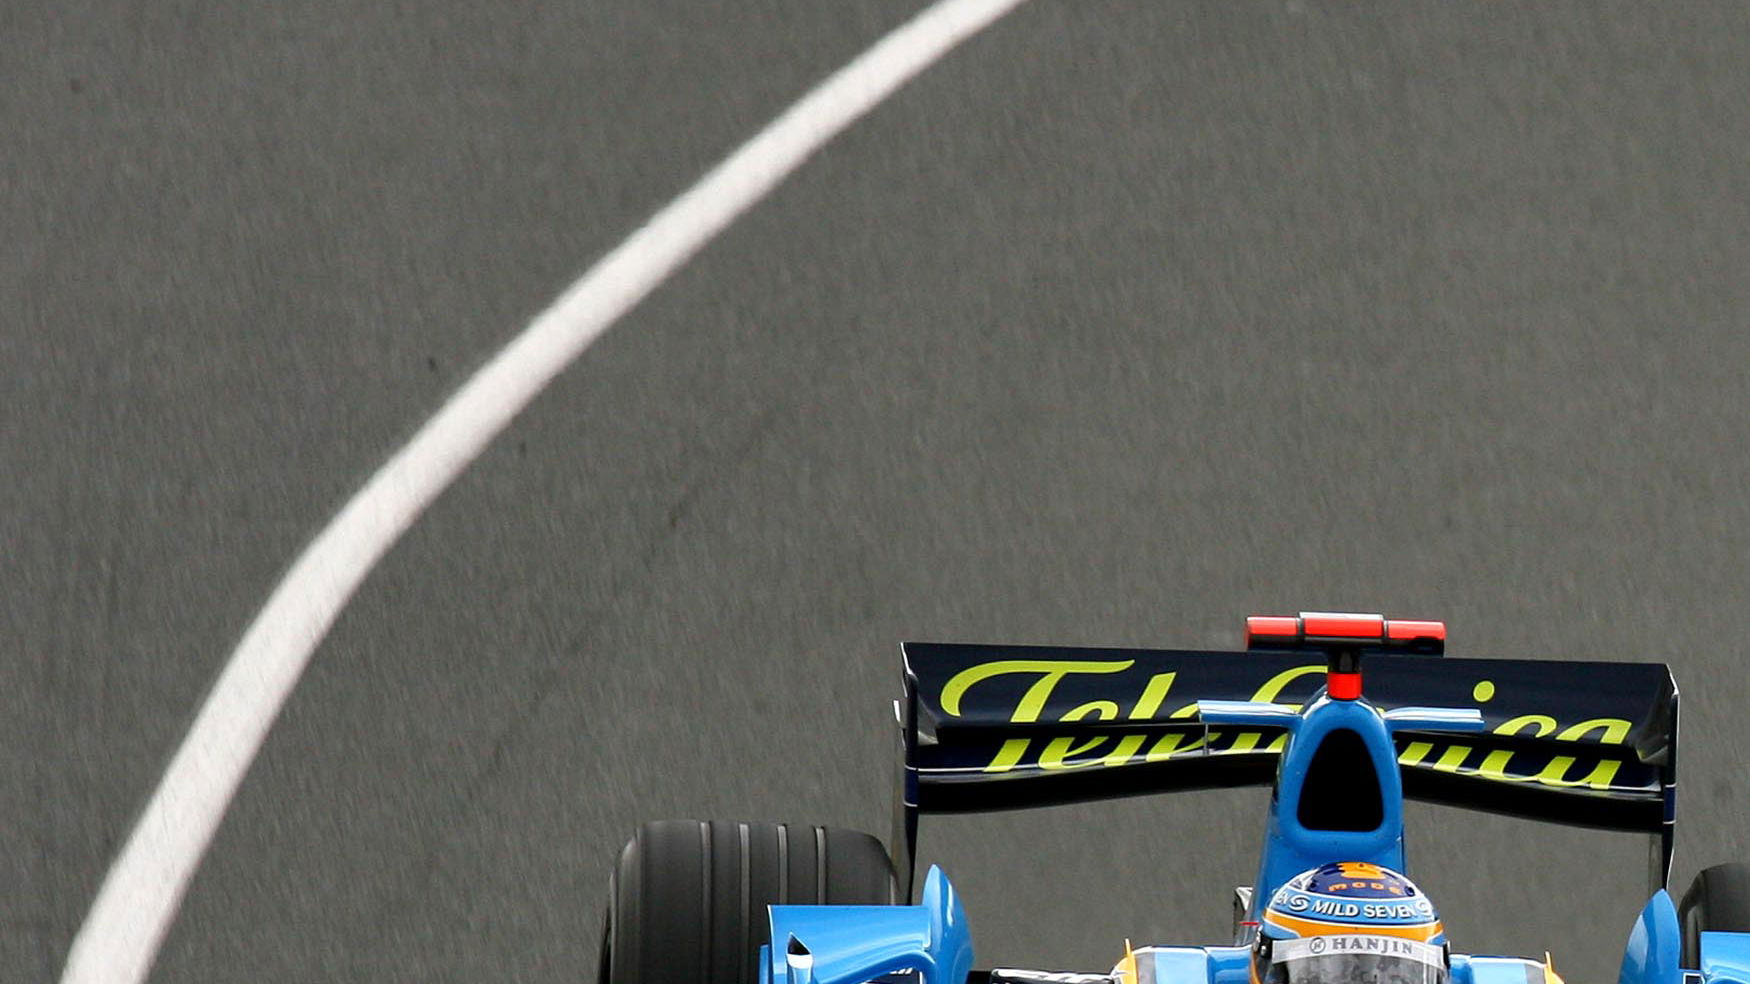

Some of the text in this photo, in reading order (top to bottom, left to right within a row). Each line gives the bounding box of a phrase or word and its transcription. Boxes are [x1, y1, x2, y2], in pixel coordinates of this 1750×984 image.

[1312, 900, 1415, 918] MILD SEVEN
[1333, 938, 1413, 954] HANJIN
